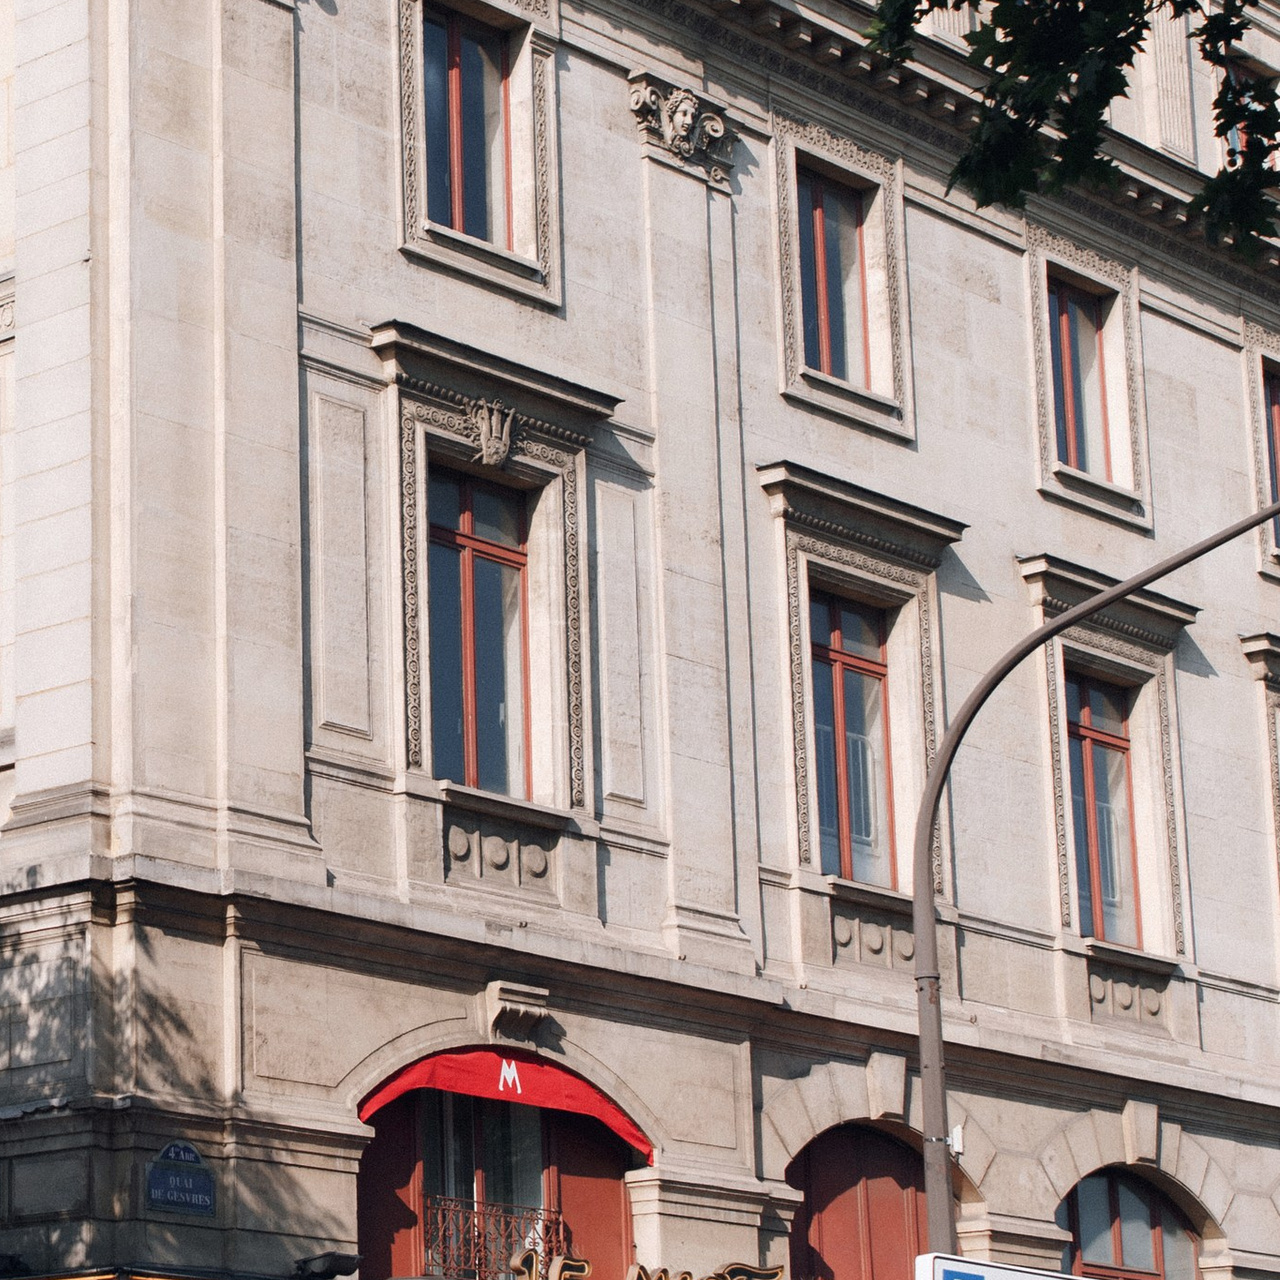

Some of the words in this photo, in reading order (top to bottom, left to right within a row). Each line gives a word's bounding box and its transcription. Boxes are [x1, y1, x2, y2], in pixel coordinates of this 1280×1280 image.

[499, 1058, 522, 1094] M
[169, 1176, 193, 1189] QUAI
[151, 1188, 164, 1200] DE
[167, 1190, 211, 1206] GESVRES
